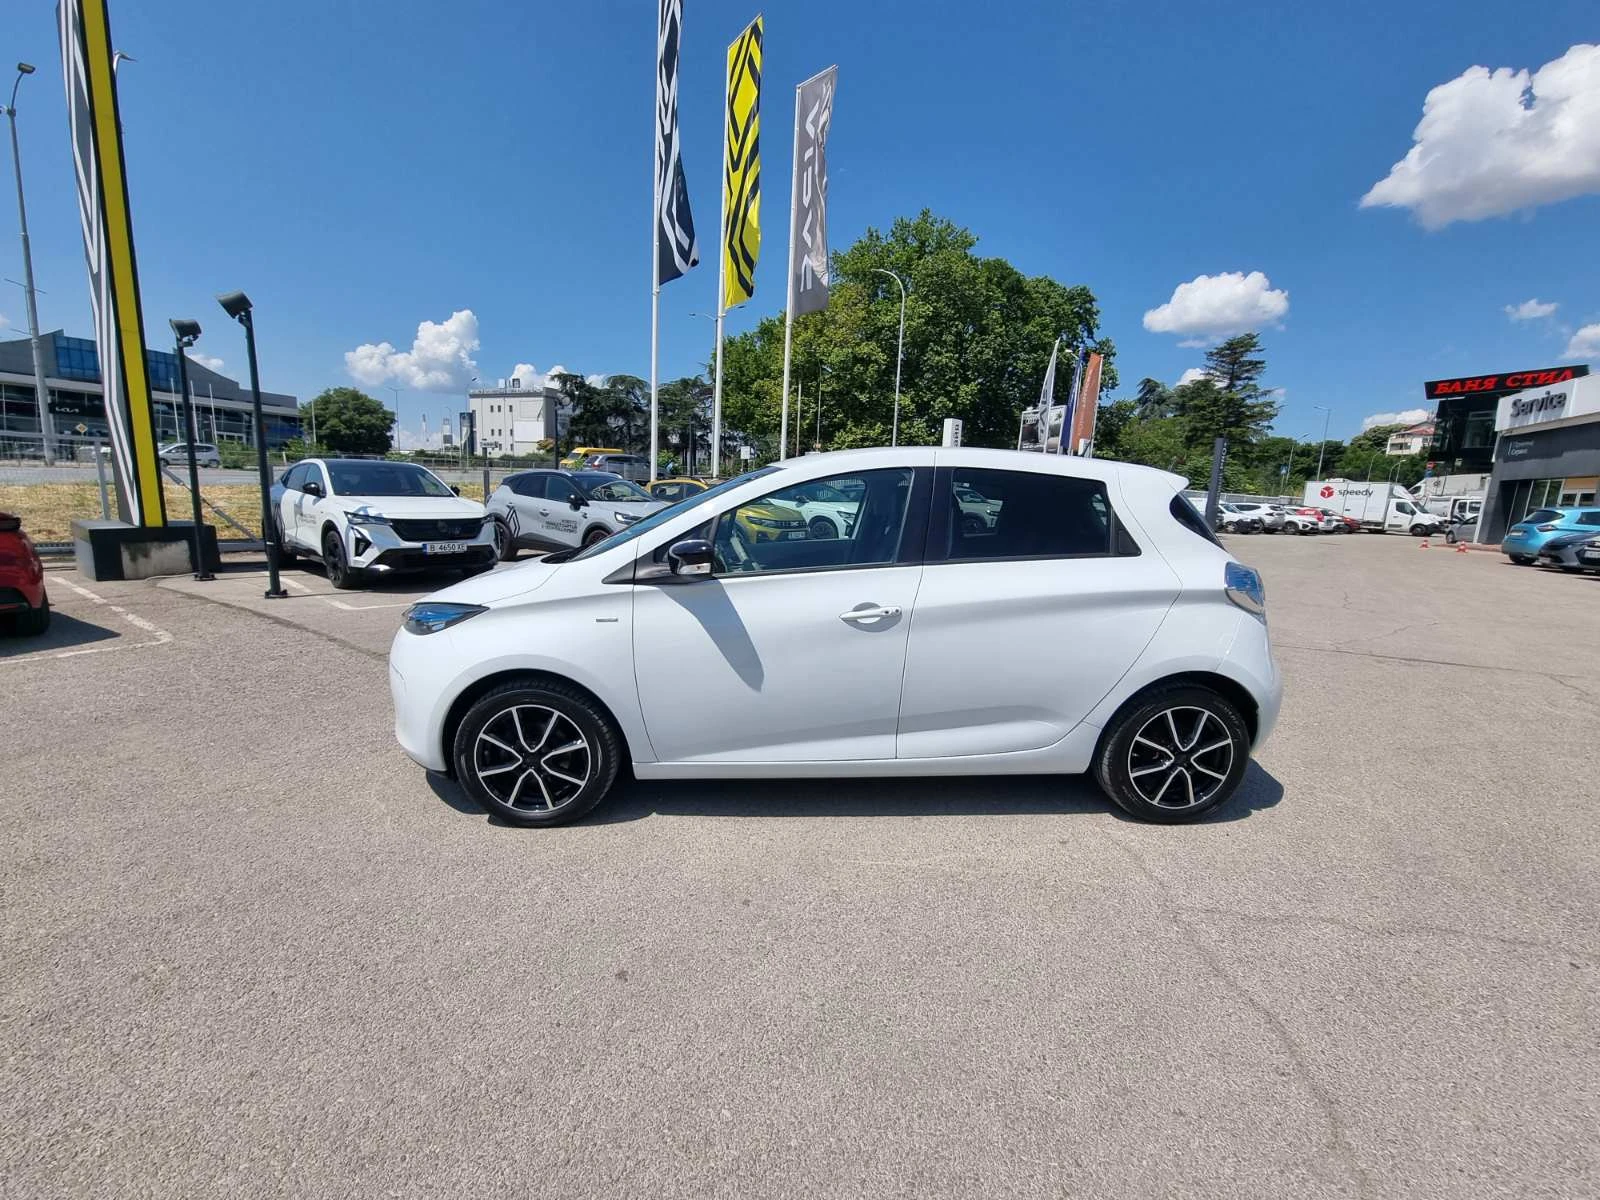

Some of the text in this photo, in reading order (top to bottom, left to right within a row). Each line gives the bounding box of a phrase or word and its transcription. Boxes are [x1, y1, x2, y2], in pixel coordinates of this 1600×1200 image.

[1434, 369, 1574, 395] БАНЯ СТИЛ
[1510, 390, 1567, 418] Service
[1337, 488, 1373, 497] speedy
[439, 543, 456, 551] 4650
